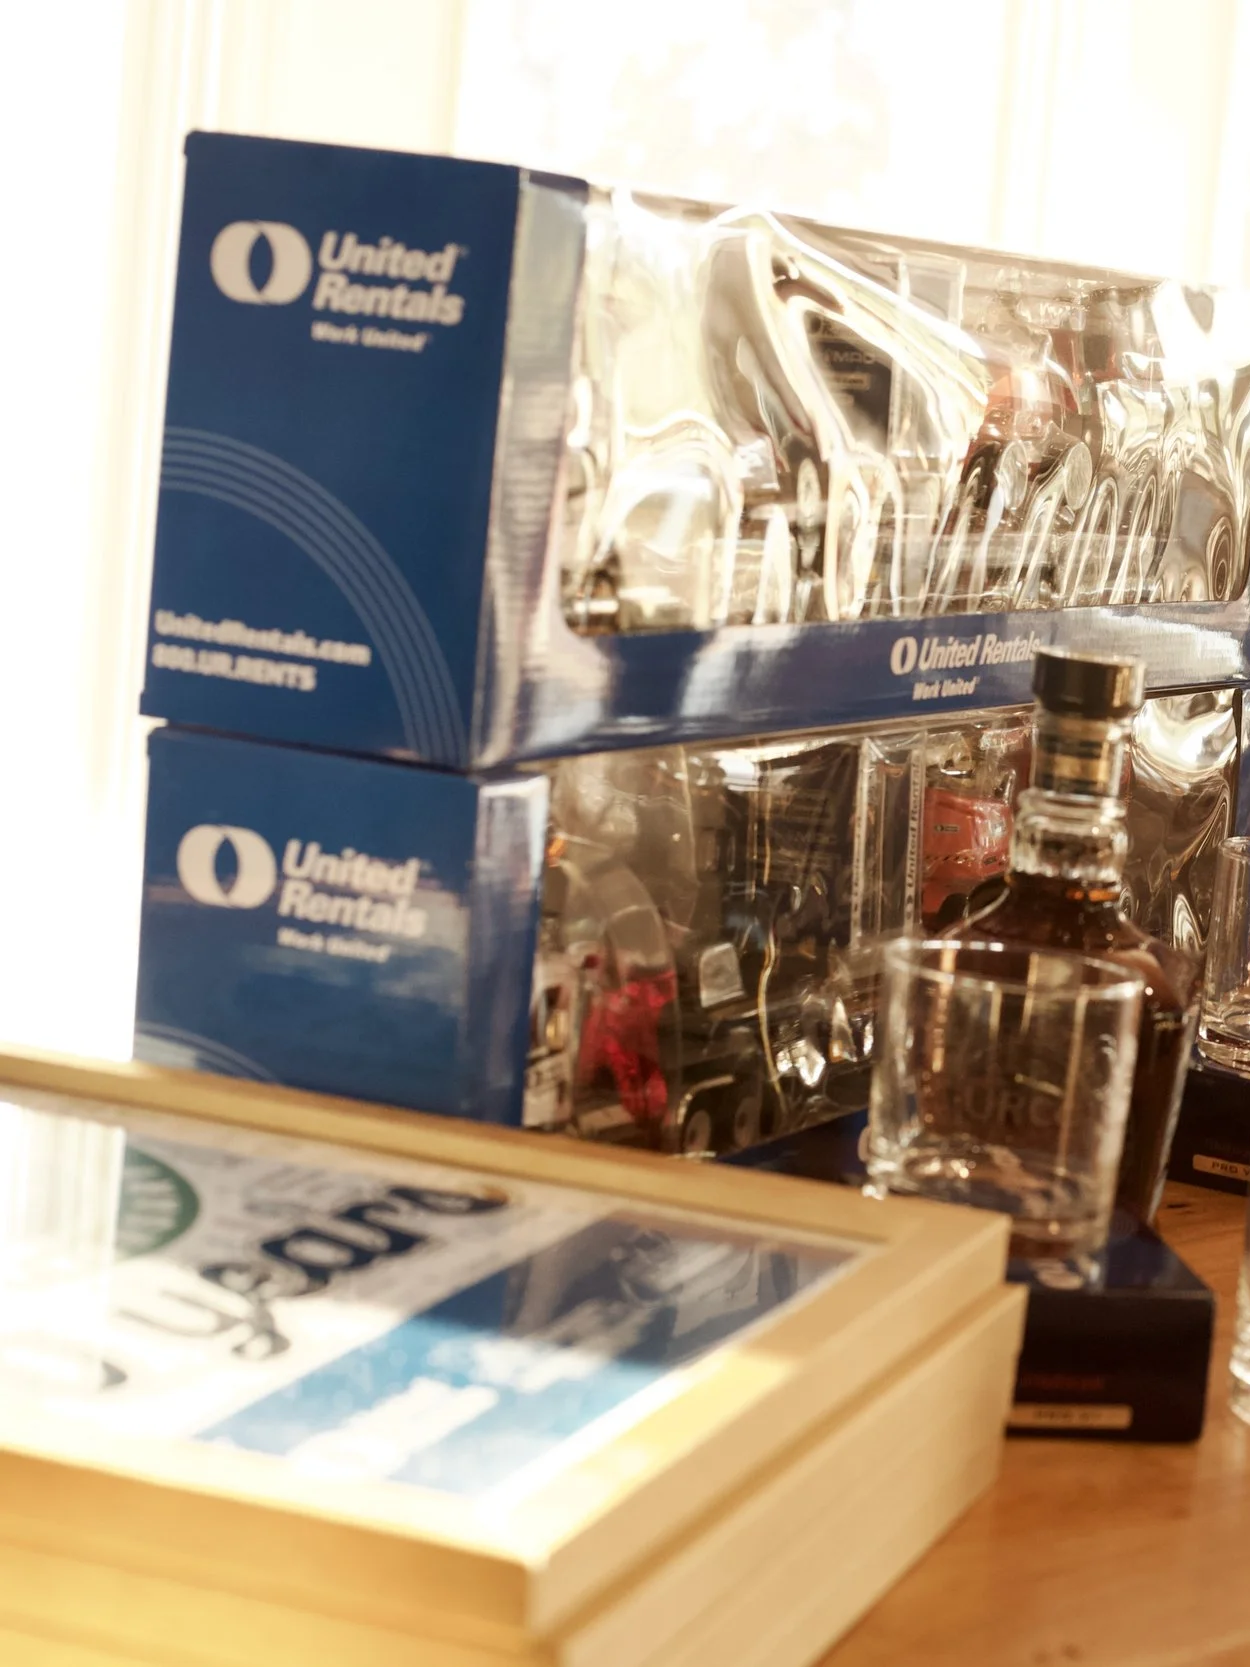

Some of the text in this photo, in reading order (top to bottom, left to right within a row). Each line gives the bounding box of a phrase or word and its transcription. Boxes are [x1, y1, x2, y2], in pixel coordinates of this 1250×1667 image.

[319, 230, 459, 283] United
[312, 272, 465, 326] Rentals
[918, 631, 1041, 671] United Rentals
[912, 677, 977, 701] Work United
[282, 839, 421, 897] United
[277, 880, 428, 938] Rentals
